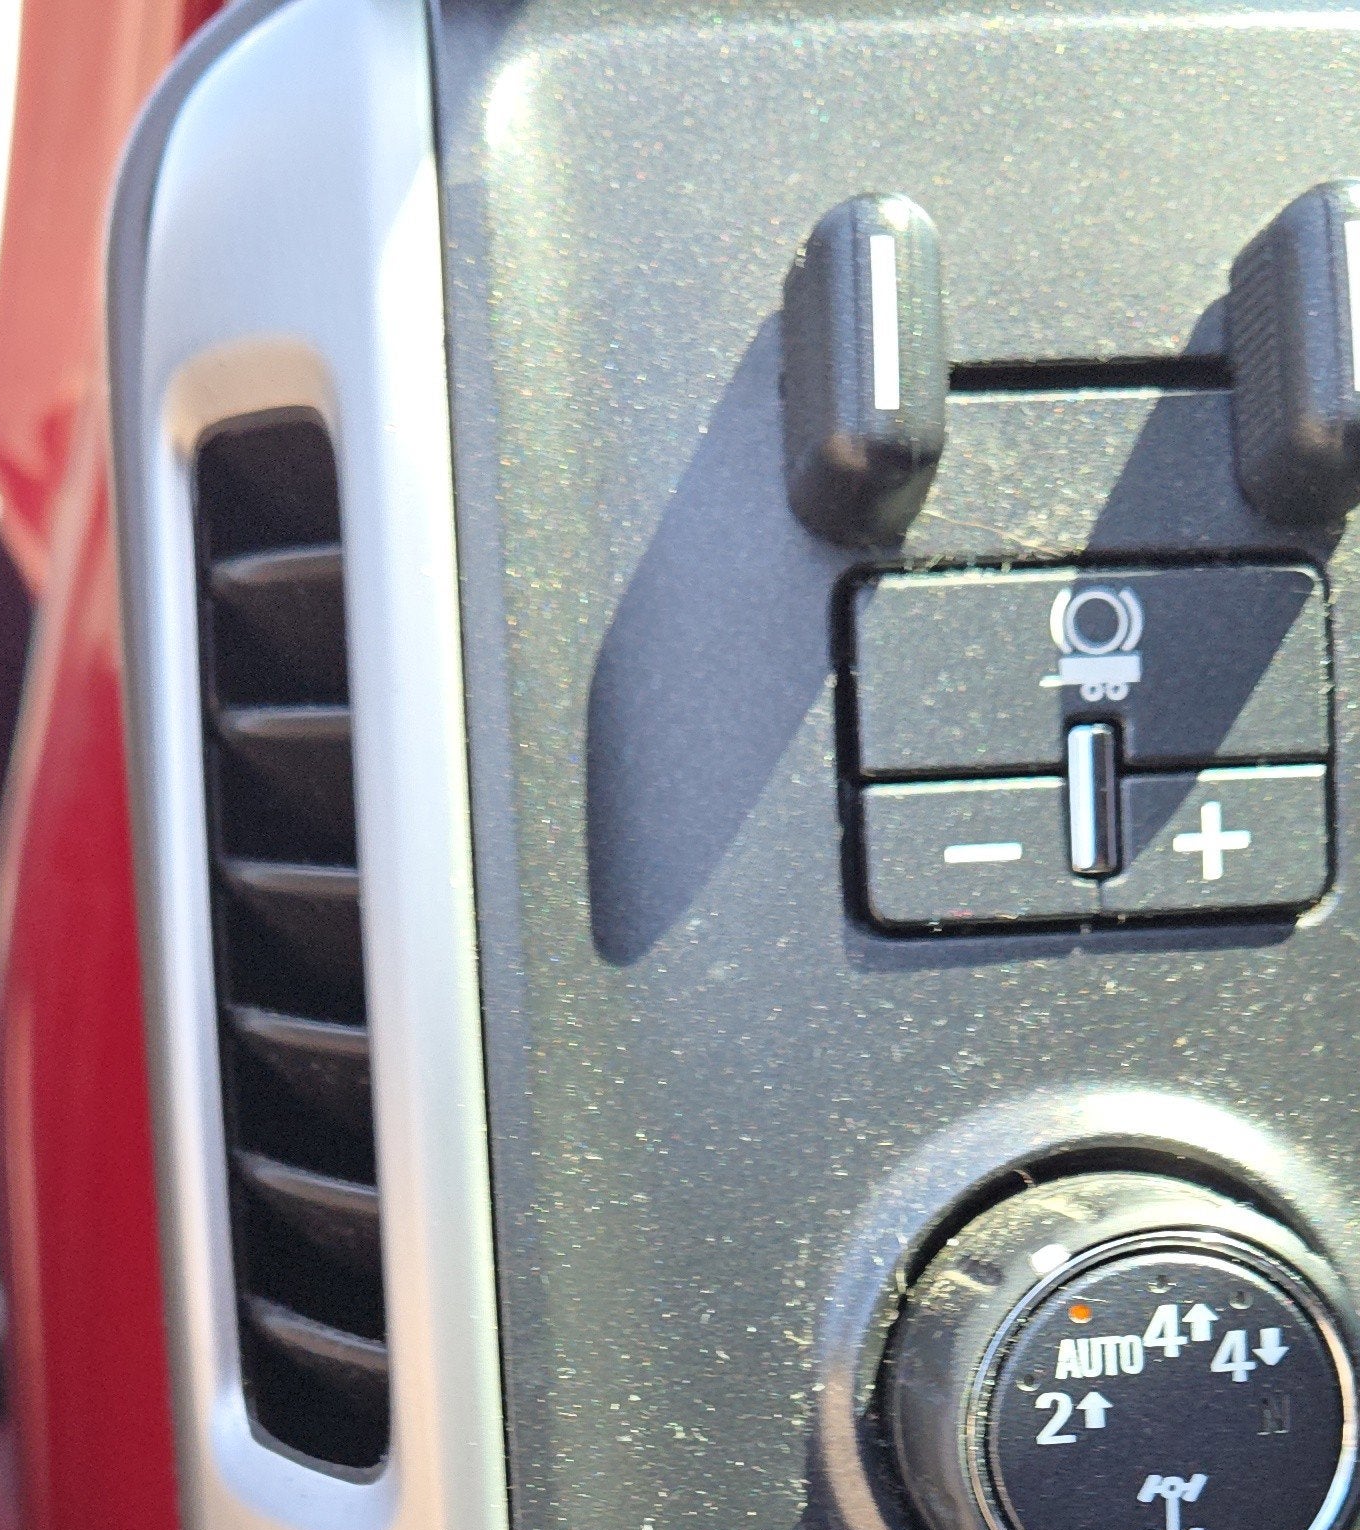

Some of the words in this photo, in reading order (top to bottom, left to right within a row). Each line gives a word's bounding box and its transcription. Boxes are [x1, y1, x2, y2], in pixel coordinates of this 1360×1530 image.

[1055, 1335, 1144, 1379] AUTO
[1144, 1304, 1188, 1357] 4
[1211, 1329, 1257, 1382] 4
[1034, 1391, 1077, 1445] 2
